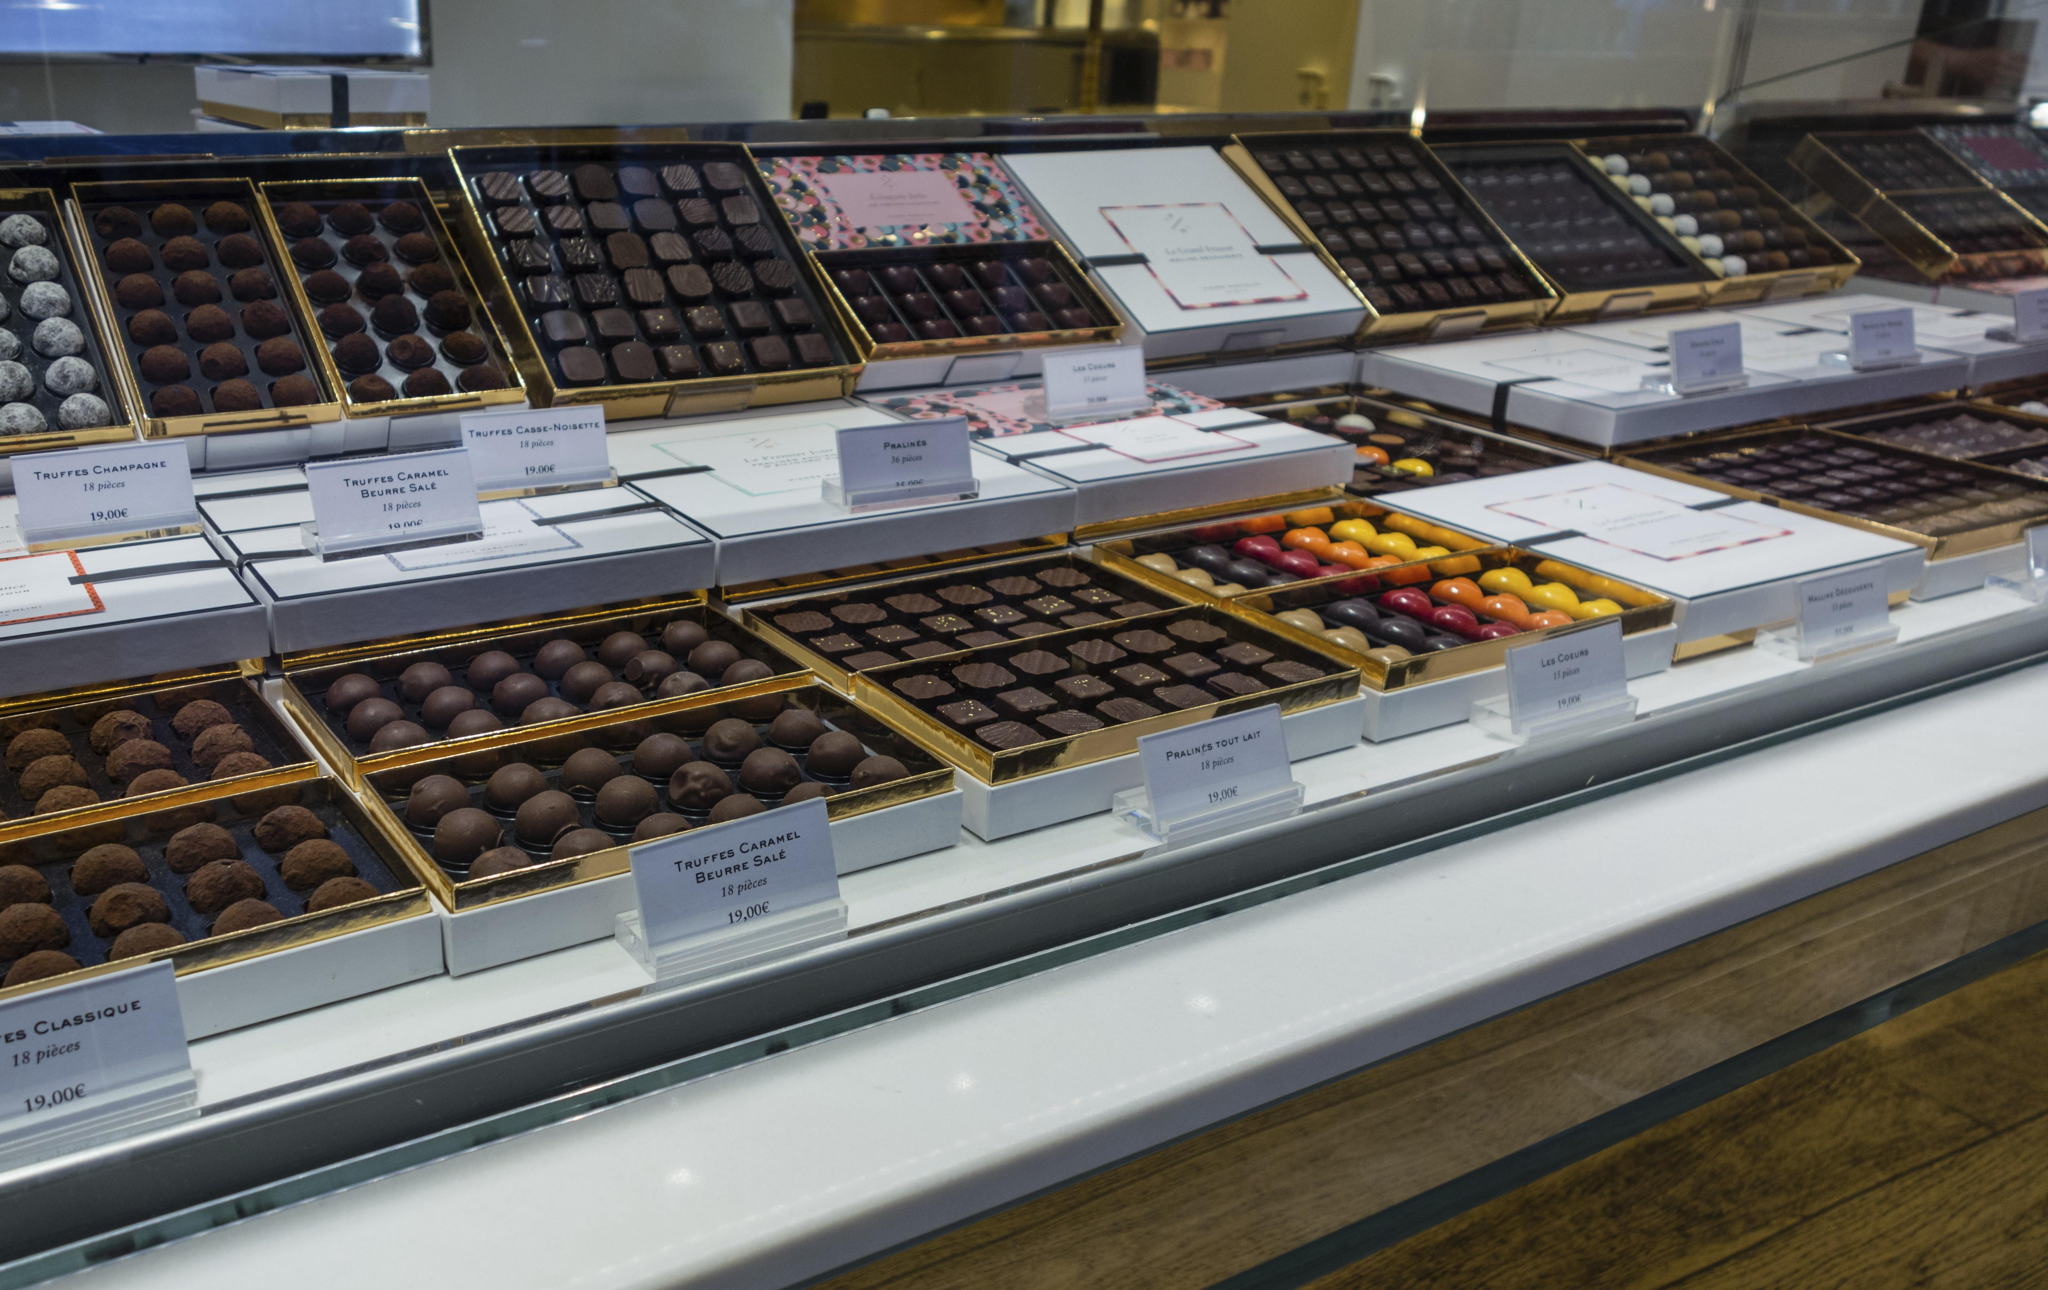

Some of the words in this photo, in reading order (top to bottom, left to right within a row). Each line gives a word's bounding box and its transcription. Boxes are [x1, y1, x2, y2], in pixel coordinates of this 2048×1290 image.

[468, 428, 513, 438] TRUFFES
[515, 421, 600, 435] CASSE-NOISETTE
[519, 440, 529, 449] 18
[531, 439, 554, 449] pièces
[891, 455, 901, 465] 36
[901, 454, 923, 465] pièces
[33, 468, 89, 481] TRUFFES
[92, 460, 168, 475] CHAMPAGNE
[343, 475, 394, 488] TRUFFES
[397, 469, 449, 481] CARAMEL
[82, 483, 95, 492] 18
[97, 480, 126, 492] pièces
[360, 487, 406, 499] BEURRE
[409, 482, 438, 493] SALÉ
[89, 508, 129, 522] 19,00€
[382, 502, 393, 512] 18
[395, 501, 422, 513] pièces
[1541, 658, 1556, 668] LES
[1557, 649, 1589, 664] COEURS
[1166, 743, 1213, 761] PRALINÉS
[1215, 736, 1239, 749] TOUT
[1242, 731, 1261, 742] LAIT
[1201, 760, 1210, 771] 18
[1212, 755, 1235, 770] pièces
[1208, 785, 1239, 804] 19,00€
[674, 849, 735, 873] TRUFFES
[739, 831, 801, 854] CARAMEL
[695, 861, 750, 884] BEURRE
[753, 848, 787, 867] SALÉ
[721, 884, 734, 898] 18
[737, 876, 768, 896] pièces
[728, 900, 771, 925] 19,00€
[0, 1029, 27, 1044] ES
[33, 1000, 142, 1035] CLASSIQUE
[12, 1050, 31, 1068] 18
[36, 1041, 81, 1064] pièces
[24, 1083, 87, 1113] 19,00€
